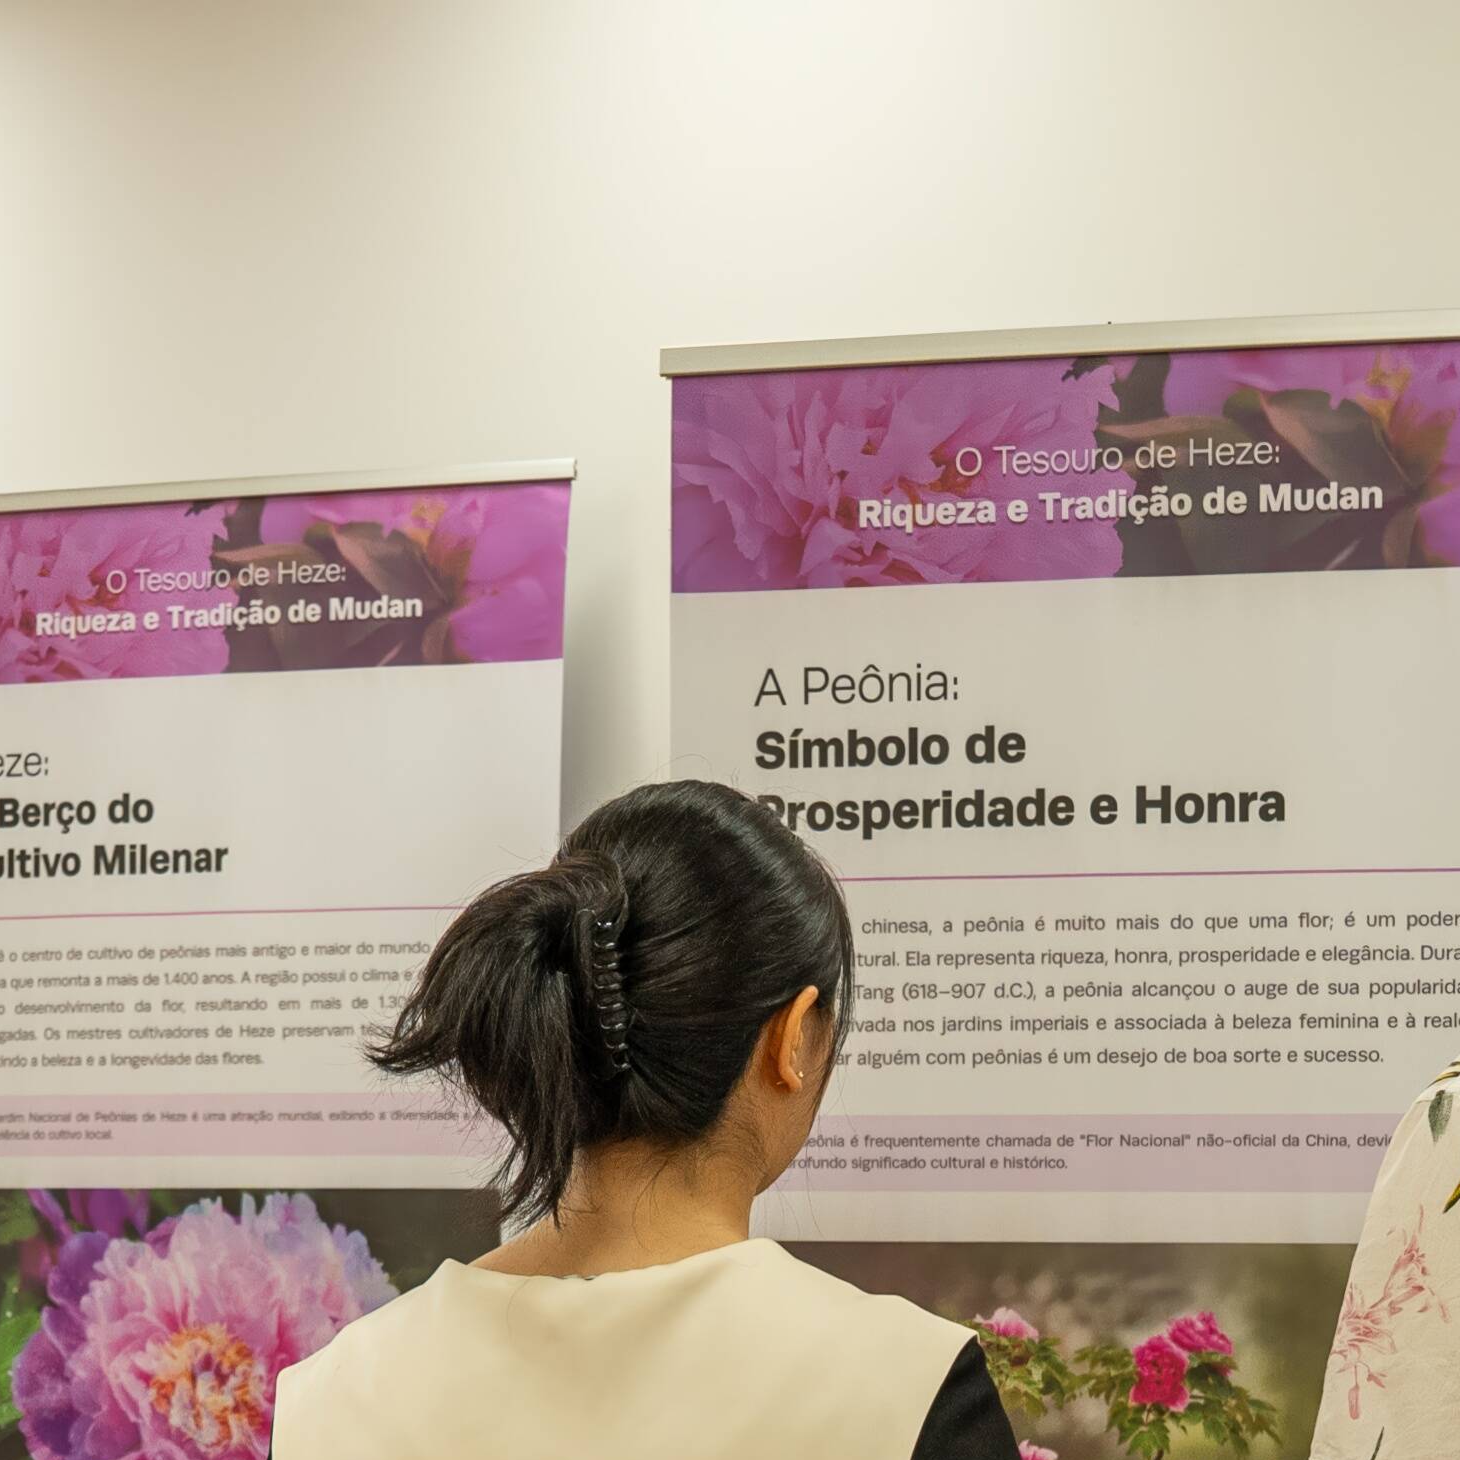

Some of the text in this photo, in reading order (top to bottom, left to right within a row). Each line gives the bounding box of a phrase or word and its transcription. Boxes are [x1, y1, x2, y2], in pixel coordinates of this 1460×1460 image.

[955, 438, 1280, 476] O Tesouro de Heze:
[859, 483, 1383, 534] Riqueza e Tradição de Mudan
[105, 561, 346, 593] O Tesouro de Heze:
[36, 596, 423, 639] Riqueza e Tradição de Mudan
[753, 662, 958, 707] A Peônia:
[754, 724, 1026, 770] Símbolo de
[107, 791, 154, 824] do
[1089, 793, 1118, 825] e
[1134, 784, 1285, 824] Honra
[93, 843, 229, 876] Milenar
[860, 918, 932, 936] chinesa,
[941, 919, 953, 933] a
[963, 915, 1024, 937] peônia
[1034, 915, 1045, 932] é
[1054, 914, 1106, 932] muito
[1115, 913, 1159, 930] mais
[1169, 913, 1194, 930] do
[1203, 915, 1238, 933] que
[1248, 914, 1288, 929] uma
[1297, 911, 1333, 931] flor;
[1343, 910, 1355, 928] é
[1365, 913, 1396, 927] um
[40, 1053, 82, 1067] beleza
[109, 1051, 192, 1070] longevidade
[193, 1051, 219, 1065] das
[221, 1050, 264, 1065] flores.
[792, 1155, 1068, 1172] rofundo significado cultural e histórico.
